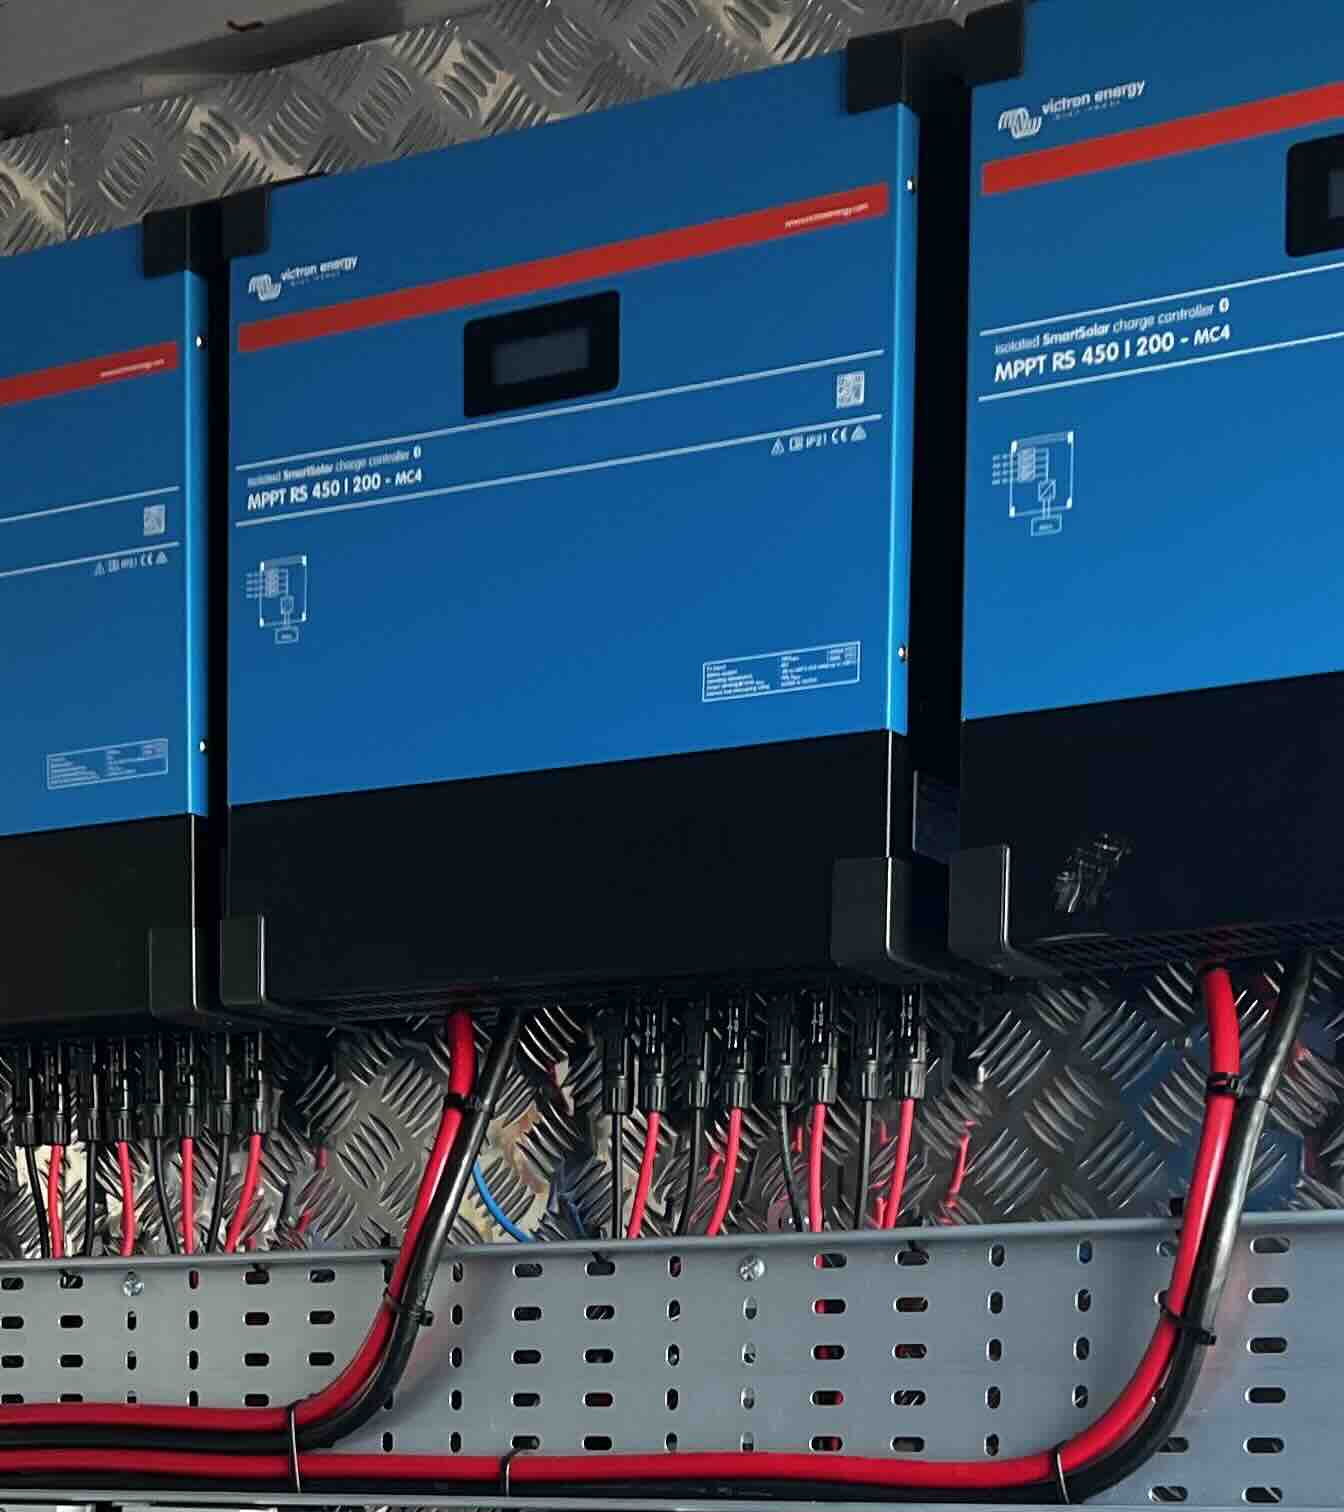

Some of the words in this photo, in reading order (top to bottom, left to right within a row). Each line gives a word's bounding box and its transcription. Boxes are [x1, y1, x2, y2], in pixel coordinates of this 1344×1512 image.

[1041, 93, 1090, 115] victron
[1094, 80, 1145, 103] energy
[1043, 322, 1111, 346] SmartSolar
[1113, 315, 1155, 333] charge
[1158, 303, 1215, 325] controller
[995, 354, 1048, 383] MPPT
[1052, 349, 1076, 372] RS
[1081, 342, 1119, 365] 450
[1136, 332, 1174, 357] 200
[1194, 323, 1230, 346] MC4
[248, 490, 287, 511] MPPT
[290, 484, 308, 503] RS
[312, 478, 340, 499] 450
[353, 472, 381, 493] 200
[394, 467, 422, 486] MC4
